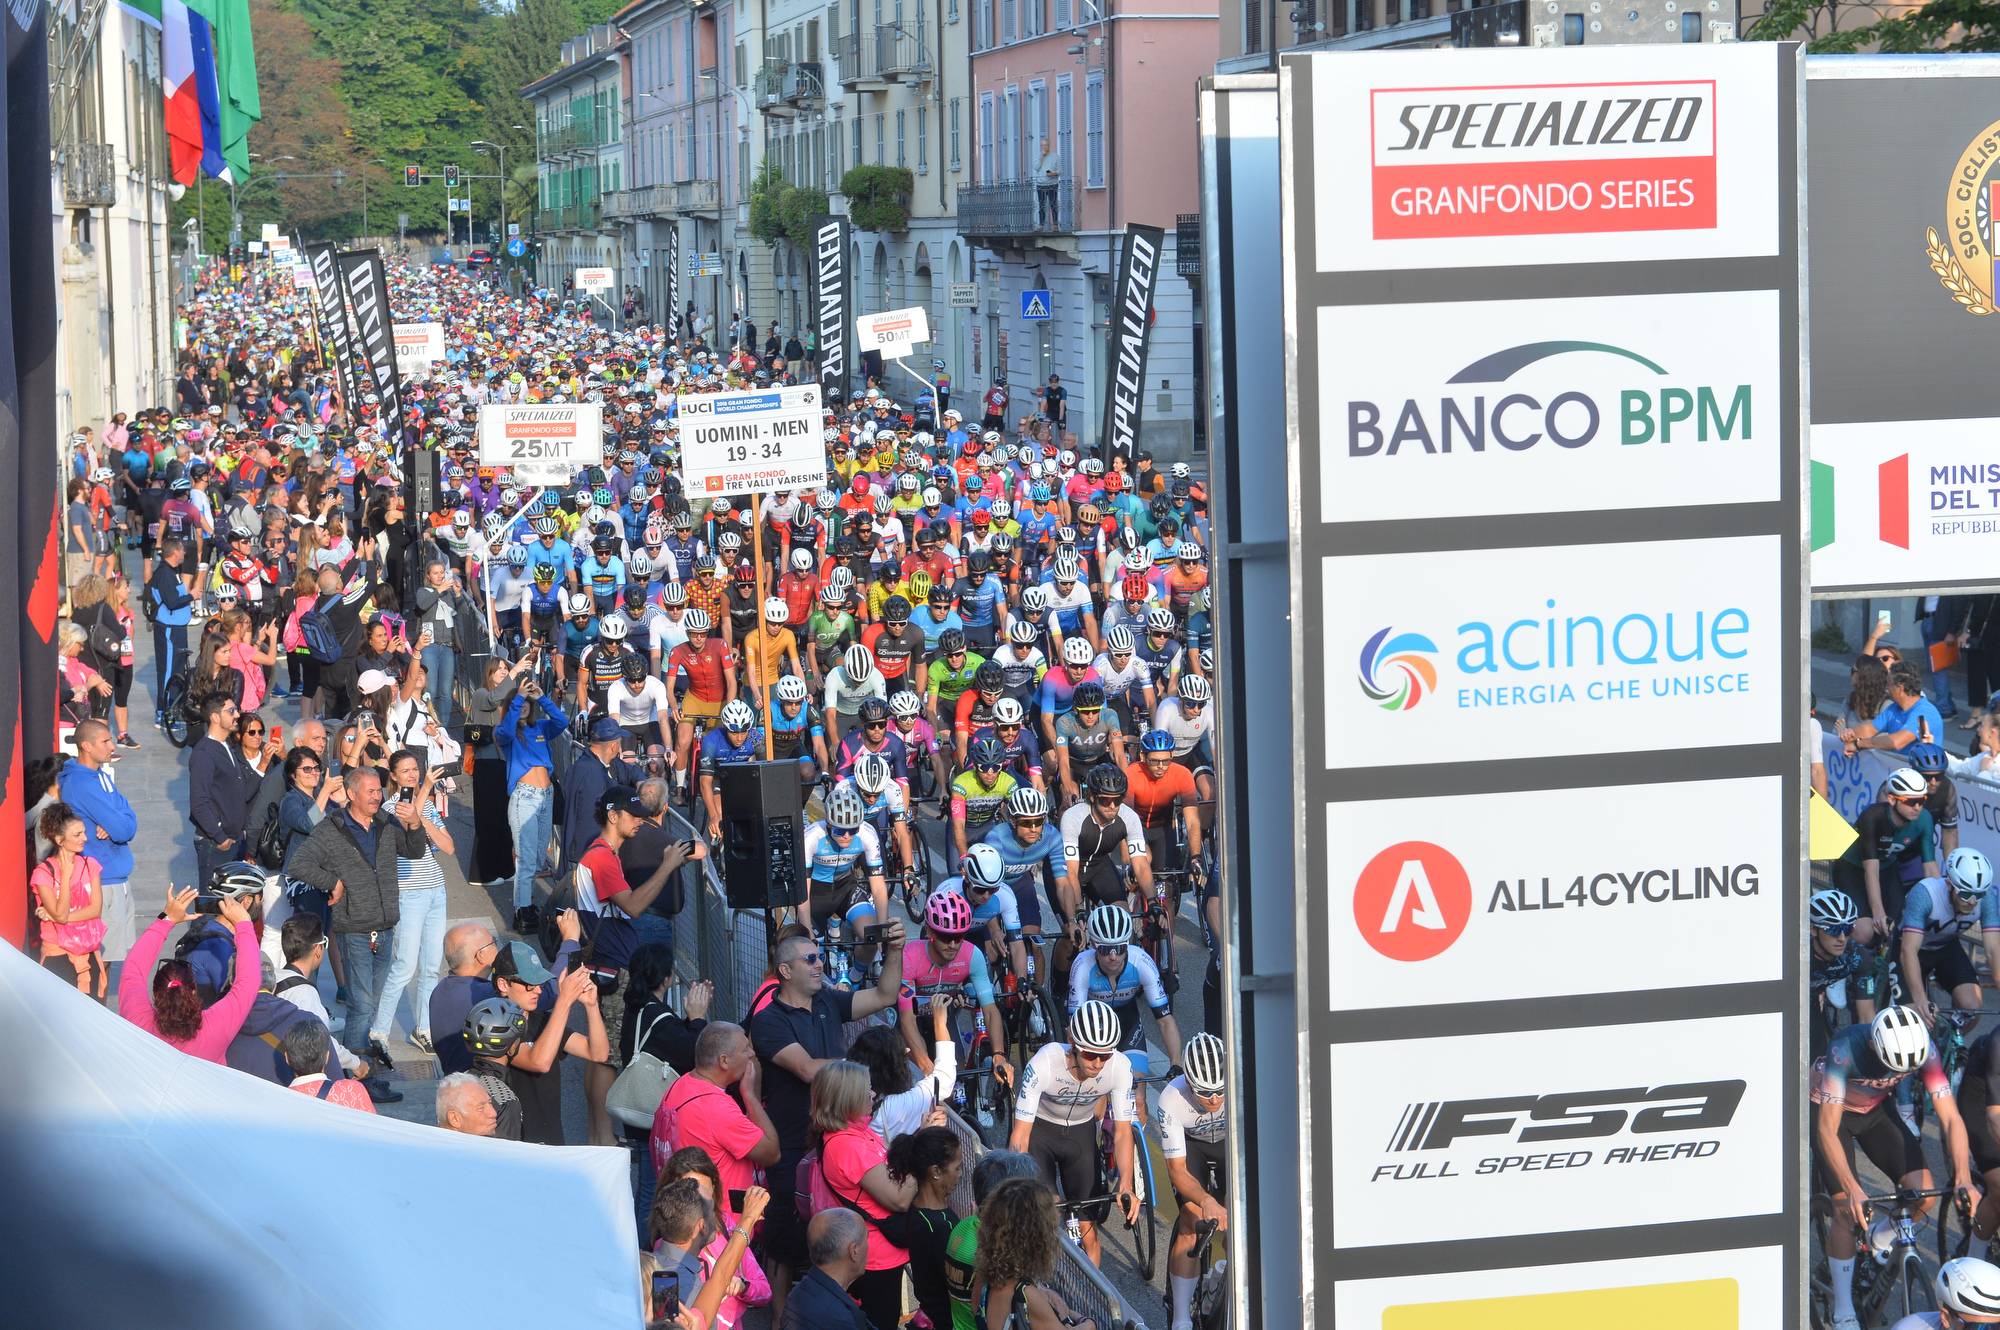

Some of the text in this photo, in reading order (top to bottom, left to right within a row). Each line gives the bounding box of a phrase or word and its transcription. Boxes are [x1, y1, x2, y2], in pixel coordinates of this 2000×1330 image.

[1387, 97, 1702, 151] SPECIALIZED
[1391, 178, 1695, 217] GRANFONDO SERIES
[1955, 209, 1979, 260] SOC.
[1112, 234, 1155, 458] SPECIALIZED
[510, 410, 574, 421] SPECIALIZED
[687, 403, 712, 414] UCI
[1348, 385, 1752, 457] BANCO BPM
[695, 424, 759, 444] UOMINI
[773, 419, 809, 437] MEN
[728, 446, 747, 462] 19
[761, 442, 782, 458] 34
[725, 469, 787, 483] GRAN FONDO
[726, 472, 824, 490] TRE VALLI VARESINE
[1931, 490, 1980, 510] DEL
[1457, 599, 1749, 674] acinque
[1459, 673, 1749, 708] ENERGIA CHE UNISCE
[1488, 864, 1759, 913] ALL4CYCLING
[1371, 1140, 1721, 1183] FULL SPEED AHEAD
